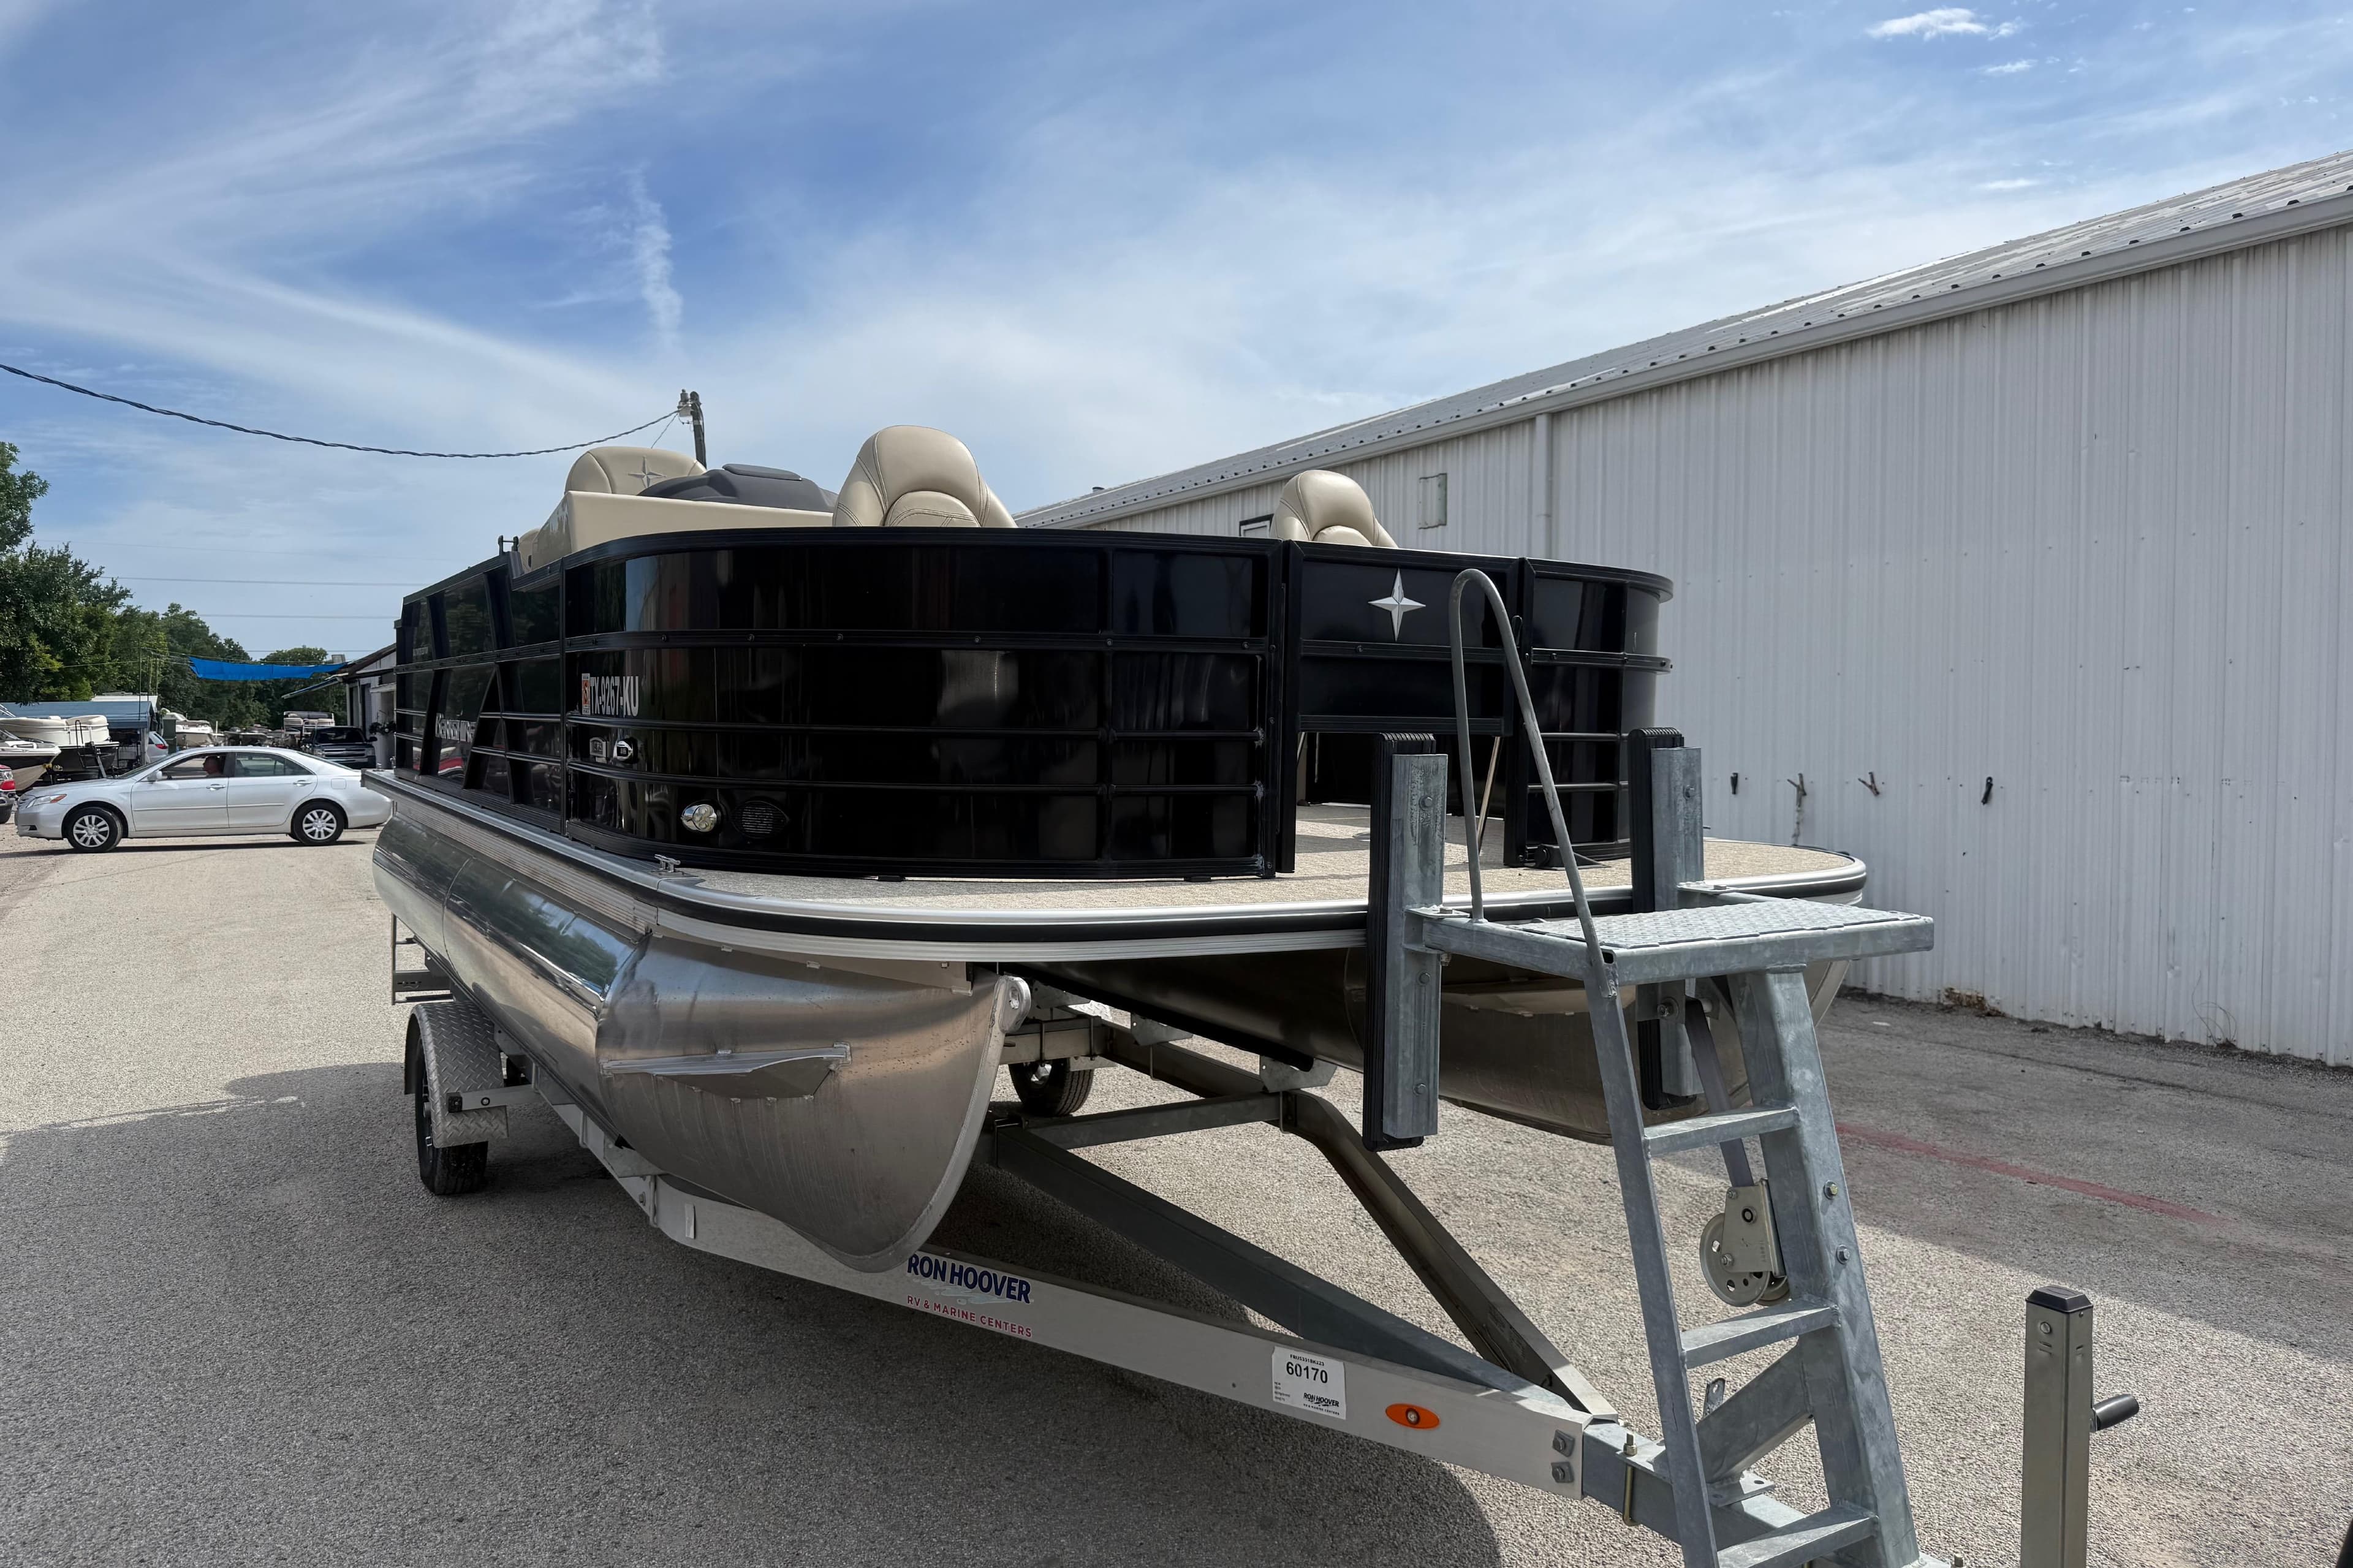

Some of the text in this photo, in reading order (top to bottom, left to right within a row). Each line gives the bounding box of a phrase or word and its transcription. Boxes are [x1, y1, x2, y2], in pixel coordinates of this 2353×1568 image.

[907, 1254, 1031, 1304] RON HOOVER
[907, 1295, 1032, 1337] RV & MARINE CENTERS
[1286, 1362, 1328, 1384] 60170
[1303, 1392, 1316, 1401] RON
[1316, 1395, 1339, 1407] HOOVER
